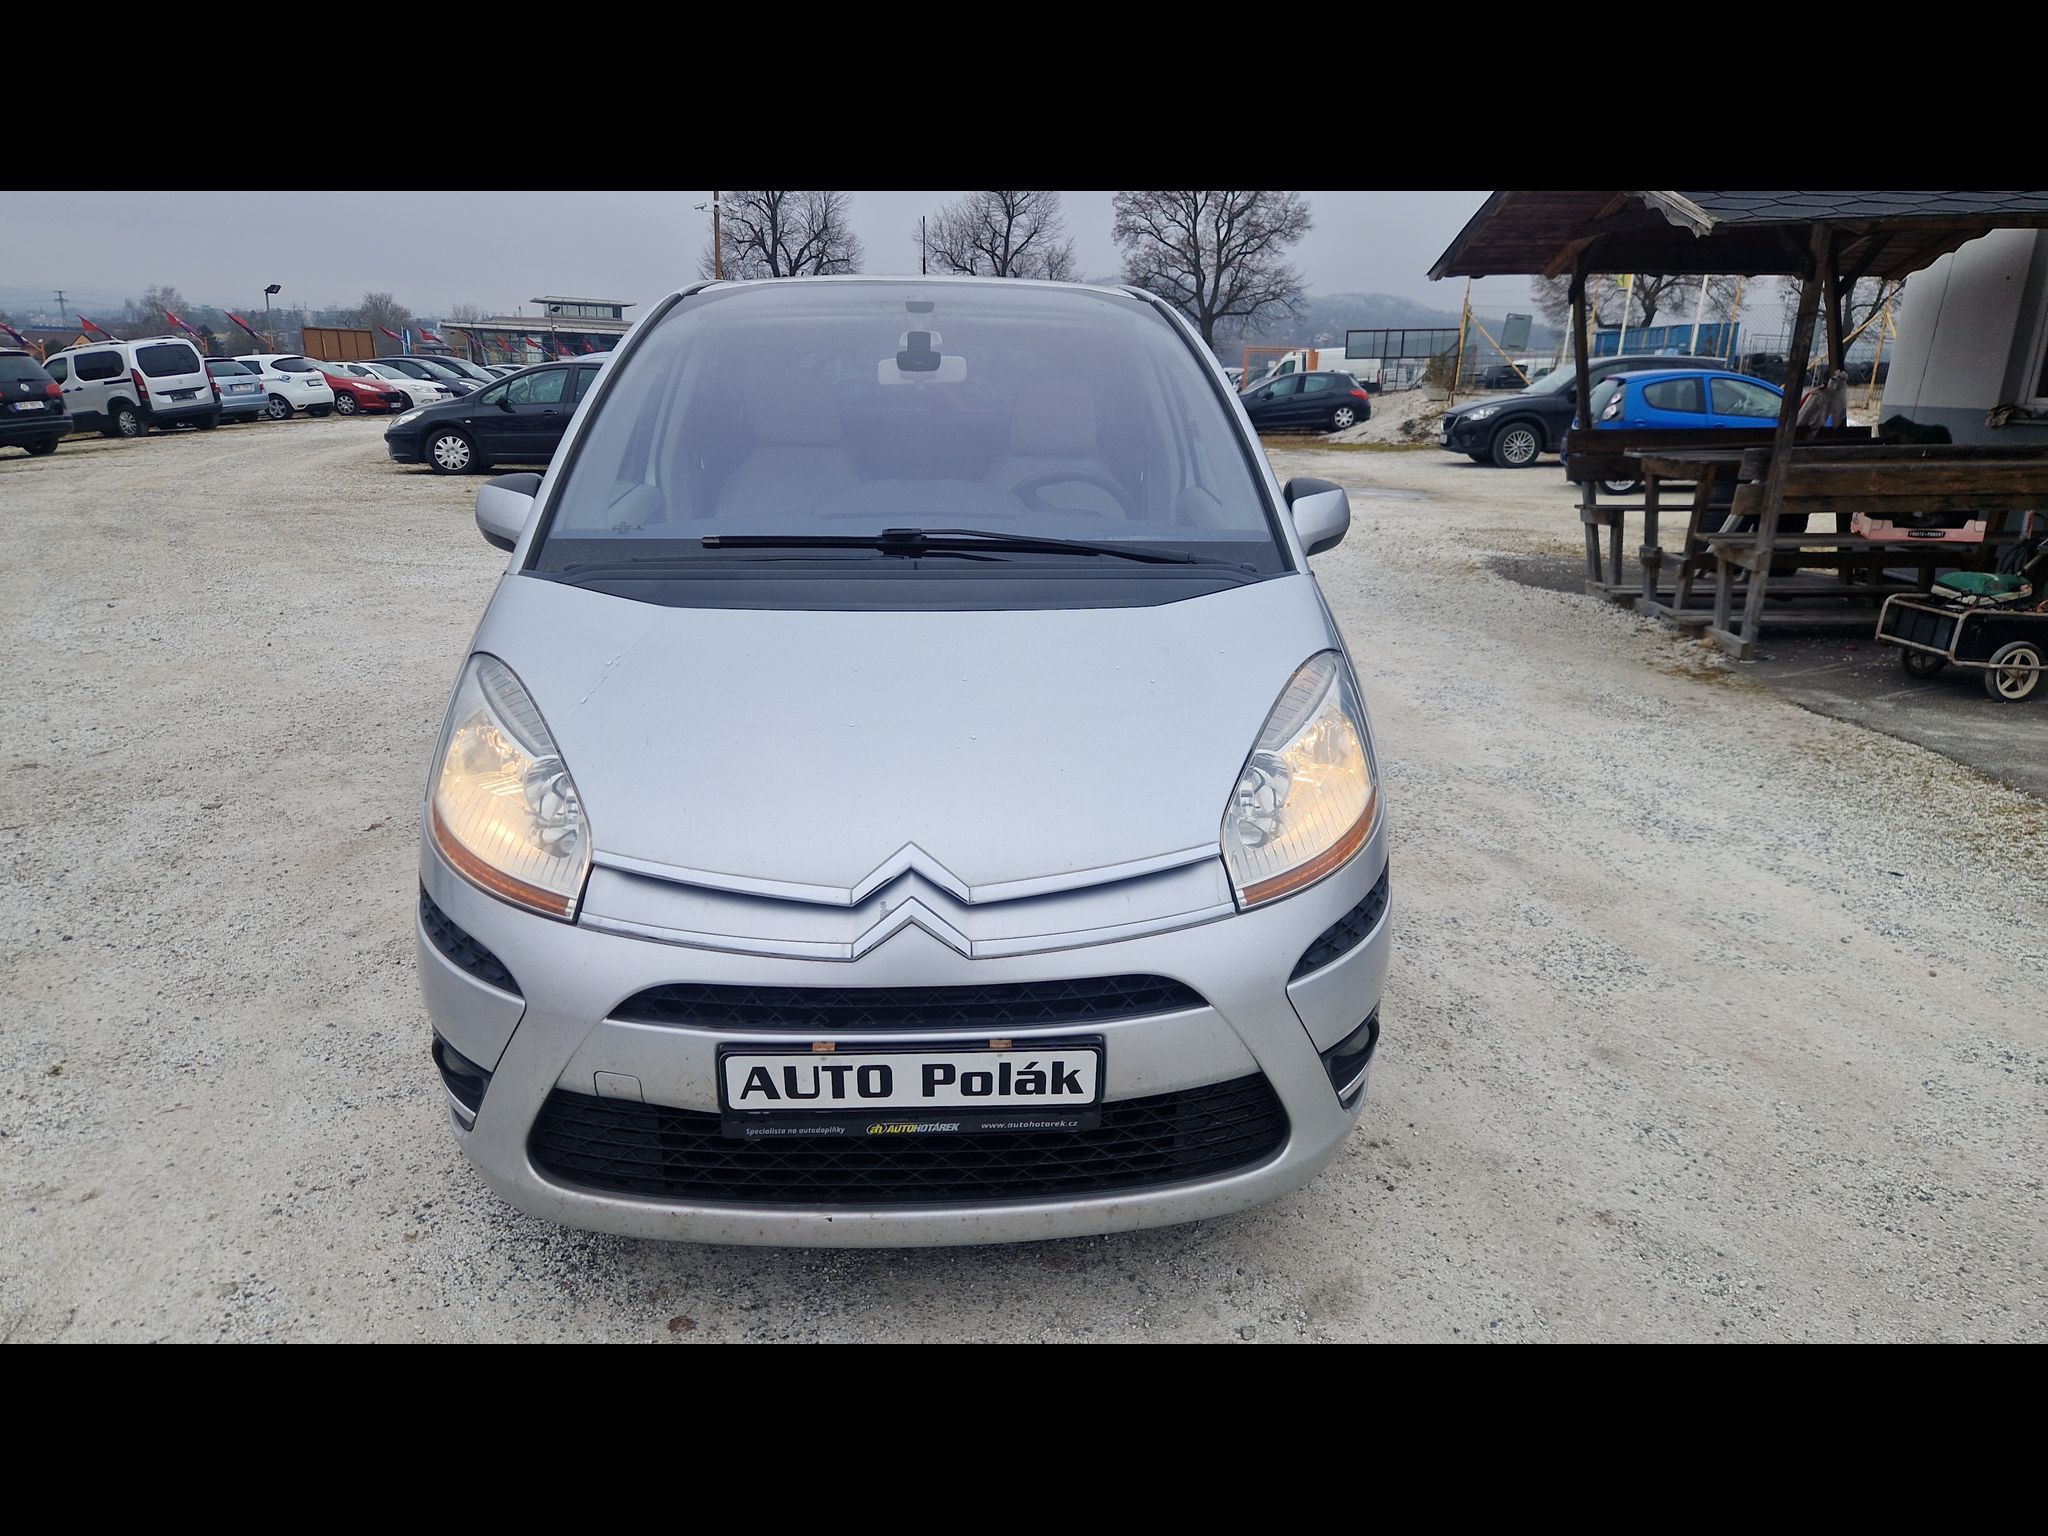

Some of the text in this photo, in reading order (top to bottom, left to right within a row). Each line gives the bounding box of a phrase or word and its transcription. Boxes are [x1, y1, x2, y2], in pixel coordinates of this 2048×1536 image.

[740, 1060, 1085, 1100] AUTO Polák
[886, 1122, 961, 1134] AUTOHOTÁREK
[980, 1119, 1079, 1130] www.autohotarek.cz
[745, 1127, 787, 1136] Specialista
